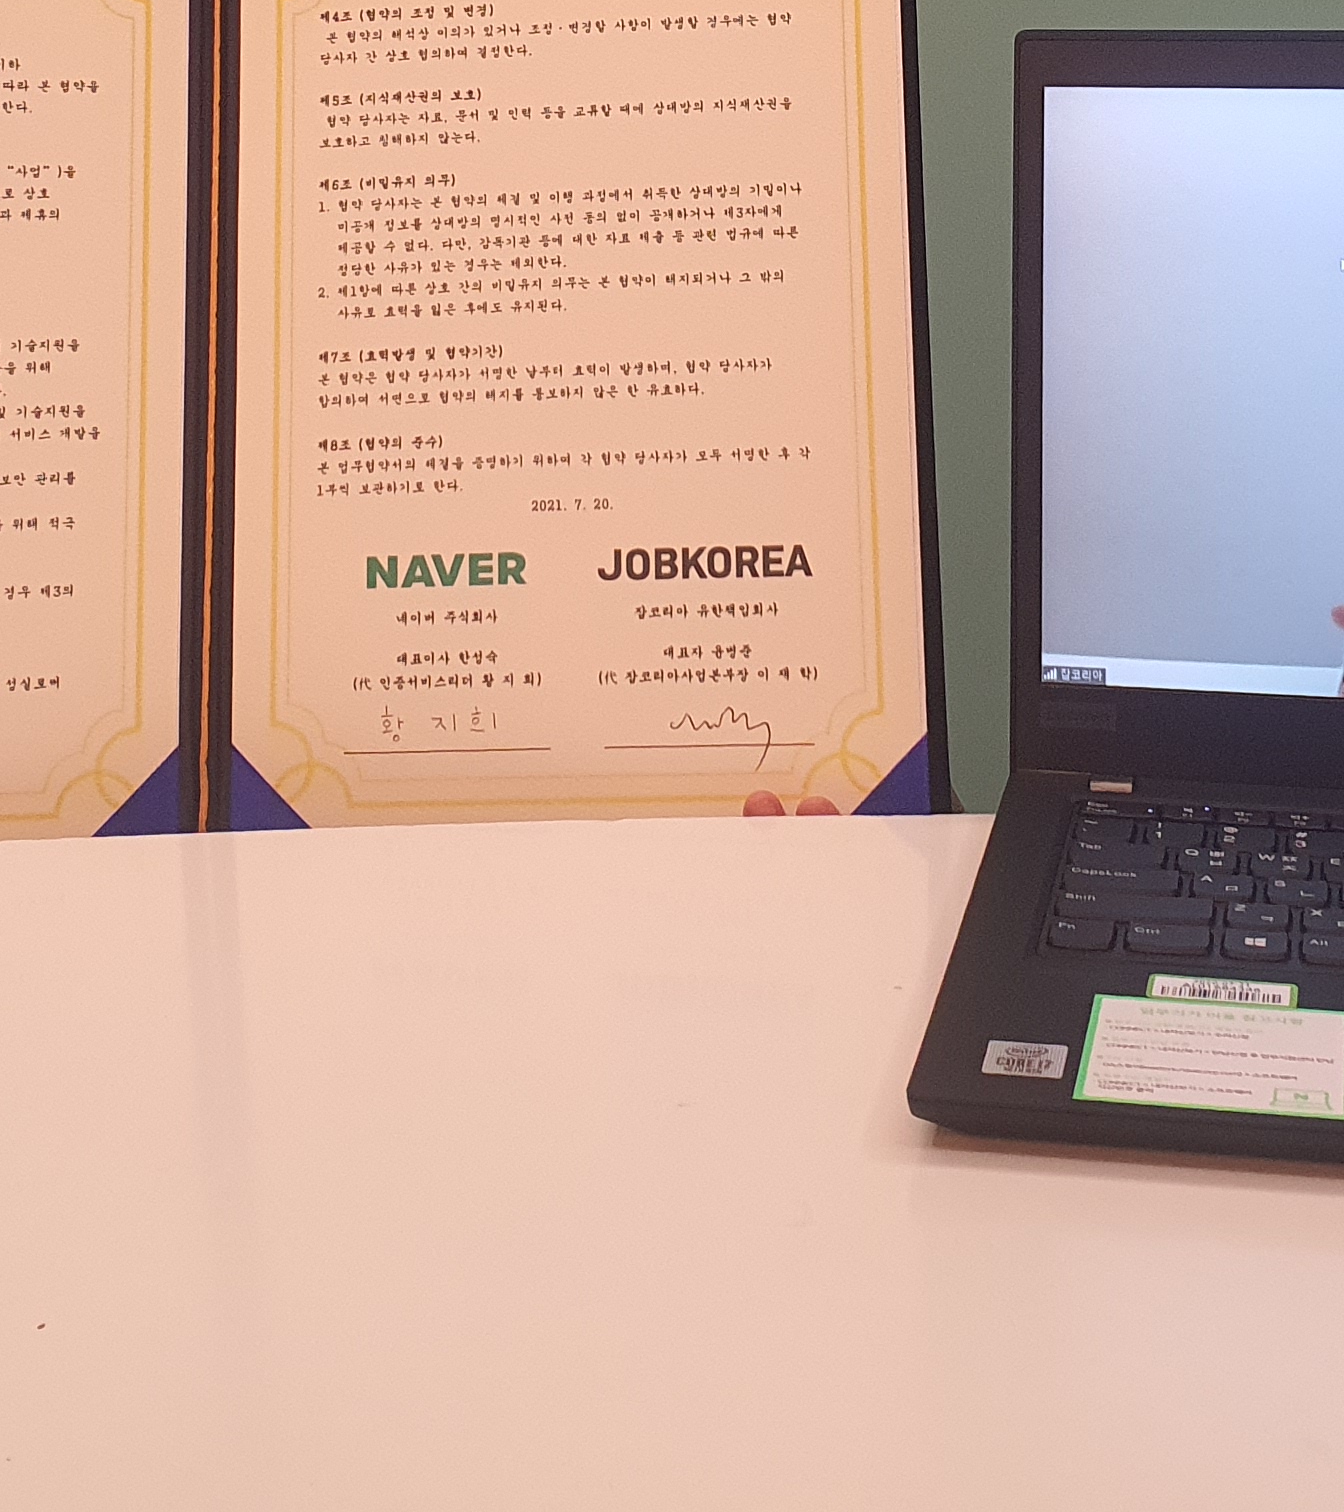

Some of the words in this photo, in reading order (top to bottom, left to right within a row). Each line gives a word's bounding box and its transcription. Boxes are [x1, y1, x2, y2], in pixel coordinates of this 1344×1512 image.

[319, 10, 353, 24] 제4조
[359, 6, 403, 23] (협약의
[410, 5, 435, 20] 조정
[443, 4, 455, 20] 및
[462, 3, 494, 18] 변경)
[319, 50, 358, 66] 당사자
[365, 49, 378, 64] 간
[385, 48, 411, 63] 상호
[417, 45, 468, 62] 협의하여
[477, 43, 533, 60] 결정한다.
[319, 93, 353, 108] 제5조
[359, 88, 442, 107] (지식재산권의
[449, 87, 482, 102] 보호)
[318, 134, 371, 149] 보호하고
[437, 129, 481, 145] 않는다.
[318, 178, 353, 193] 제6조
[423, 173, 456, 188] 의무)
[337, 261, 376, 277] 정당한
[383, 259, 423, 276] 사유가
[430, 259, 456, 274] 있는
[464, 257, 503, 273] 경우는
[510, 254, 567, 270] 제외한다.
[337, 305, 376, 320] 사유로
[383, 303, 423, 319] 효력을
[463, 300, 503, 316] 후에도
[510, 298, 567, 314] 유지된다.
[318, 350, 352, 365] 제7조
[424, 346, 436, 362] 및
[445, 343, 504, 361] 협약기간)
[318, 392, 369, 409] 합의하여
[378, 391, 431, 406] 서면으로
[438, 388, 476, 405] 협약의
[626, 382, 640, 399] 한
[646, 381, 705, 397] 유효하다.
[317, 438, 352, 453] 제8조
[358, 435, 403, 453] (협약의
[410, 434, 444, 450] 준수)
[531, 498, 567, 512] 2021.
[574, 498, 587, 511] 7.
[593, 497, 614, 511] 20.
[367, 552, 526, 589] NAVER
[598, 545, 812, 580] JOBKOREA
[395, 610, 435, 627] 네이버
[443, 608, 498, 625] 주식회사
[635, 603, 689, 621] 잡코리아
[396, 650, 451, 667] 대표이사
[458, 649, 498, 666] 한성숙
[662, 644, 704, 661] 대표자
[379, 672, 473, 692] 인증서비스리더
[481, 672, 495, 689] 황
[502, 672, 514, 688] 지
[624, 666, 750, 685] 잡코리아사업본부장
[756, 666, 769, 682] 이
[1060, 668, 1104, 682] 잡코리아
[381, 705, 404, 742] 황
[432, 714, 456, 731] 지
[1258, 853, 1275, 861] W
